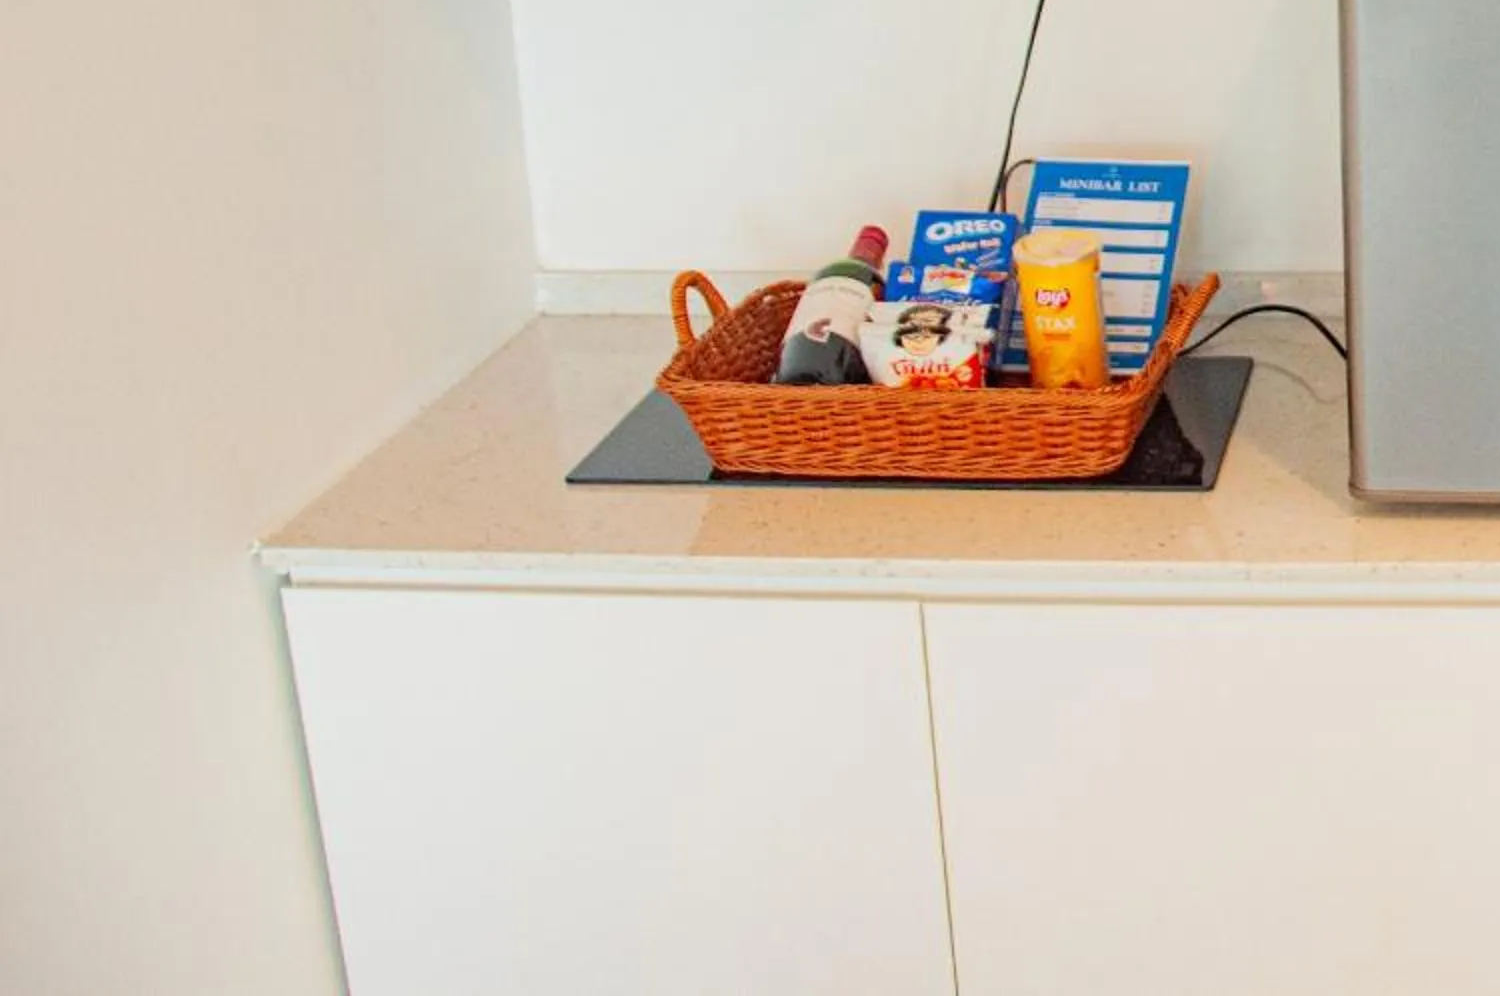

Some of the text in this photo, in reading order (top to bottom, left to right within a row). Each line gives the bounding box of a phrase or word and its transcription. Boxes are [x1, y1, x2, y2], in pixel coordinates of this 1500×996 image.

[1060, 177, 1161, 193] MINIBAR LIST
[925, 219, 1007, 241] OREO
